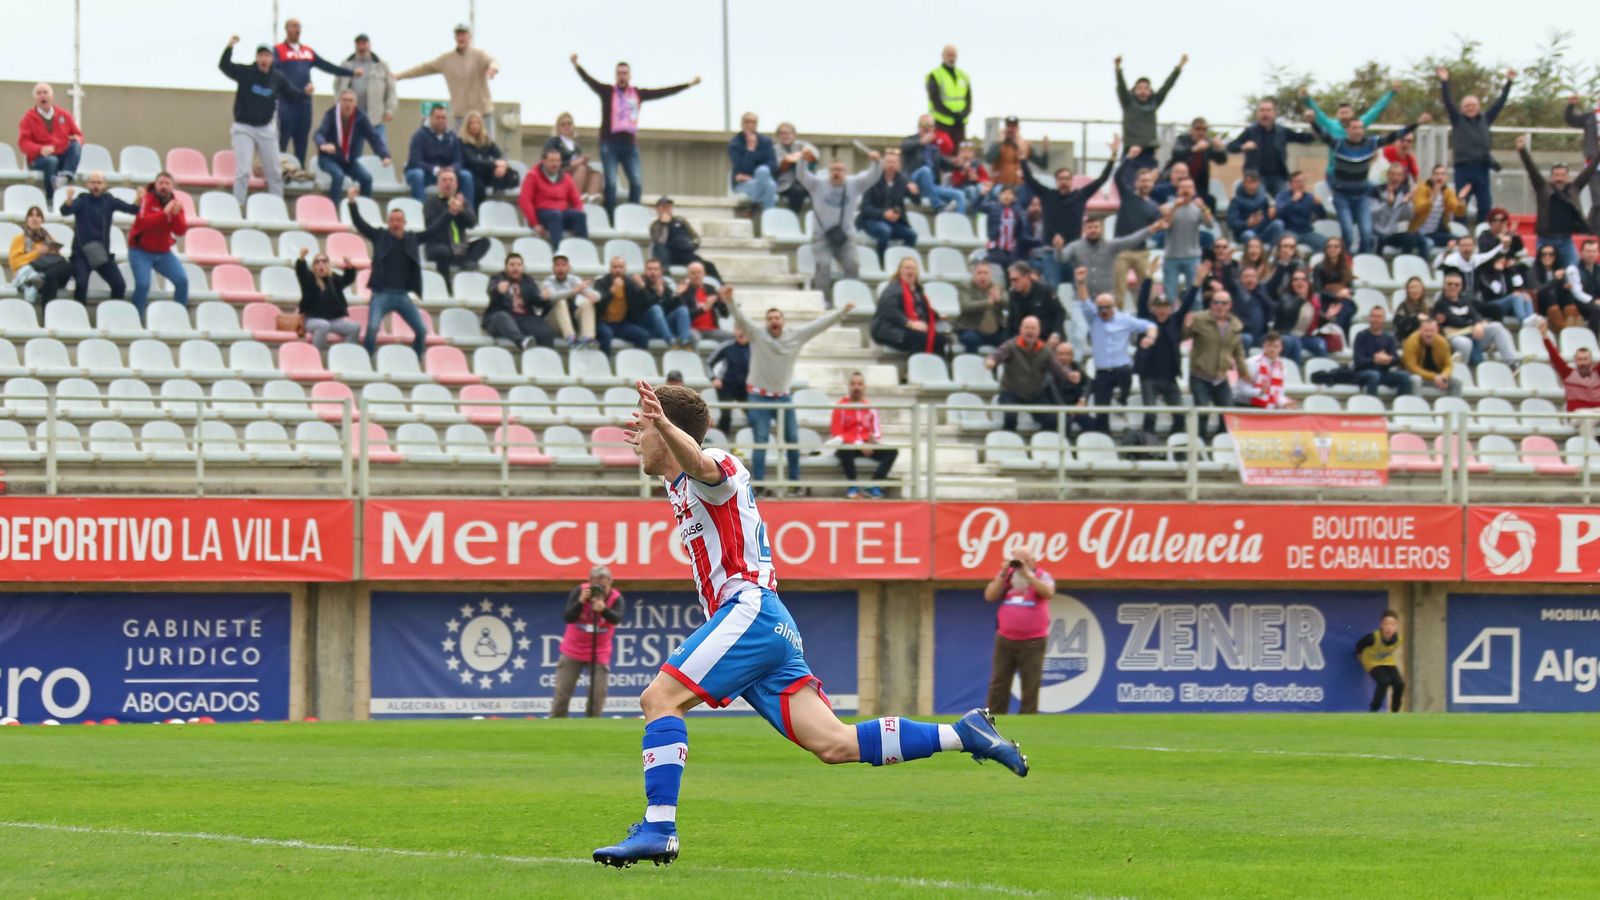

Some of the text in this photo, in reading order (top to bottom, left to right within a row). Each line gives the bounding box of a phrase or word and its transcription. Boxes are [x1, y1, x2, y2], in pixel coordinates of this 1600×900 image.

[182, 518, 222, 561] LA
[232, 518, 322, 561] VILLA
[774, 521, 921, 564] OTEL
[1079, 508, 1263, 569] Valencia
[1313, 516, 1415, 540] BOUTIQUE
[1556, 513, 1600, 573] P
[1287, 546, 1450, 569] DE CABALLEROS
[122, 619, 262, 638] GABINETE
[1541, 608, 1600, 621] MOBILIA
[1116, 603, 1325, 671] ZENER
[125, 647, 261, 671] JURIDICO
[1534, 649, 1600, 692] Alg
[0, 666, 91, 719] ro
[122, 692, 260, 713] ABOGADOS
[1117, 683, 1323, 702] Marine Elevator Services
